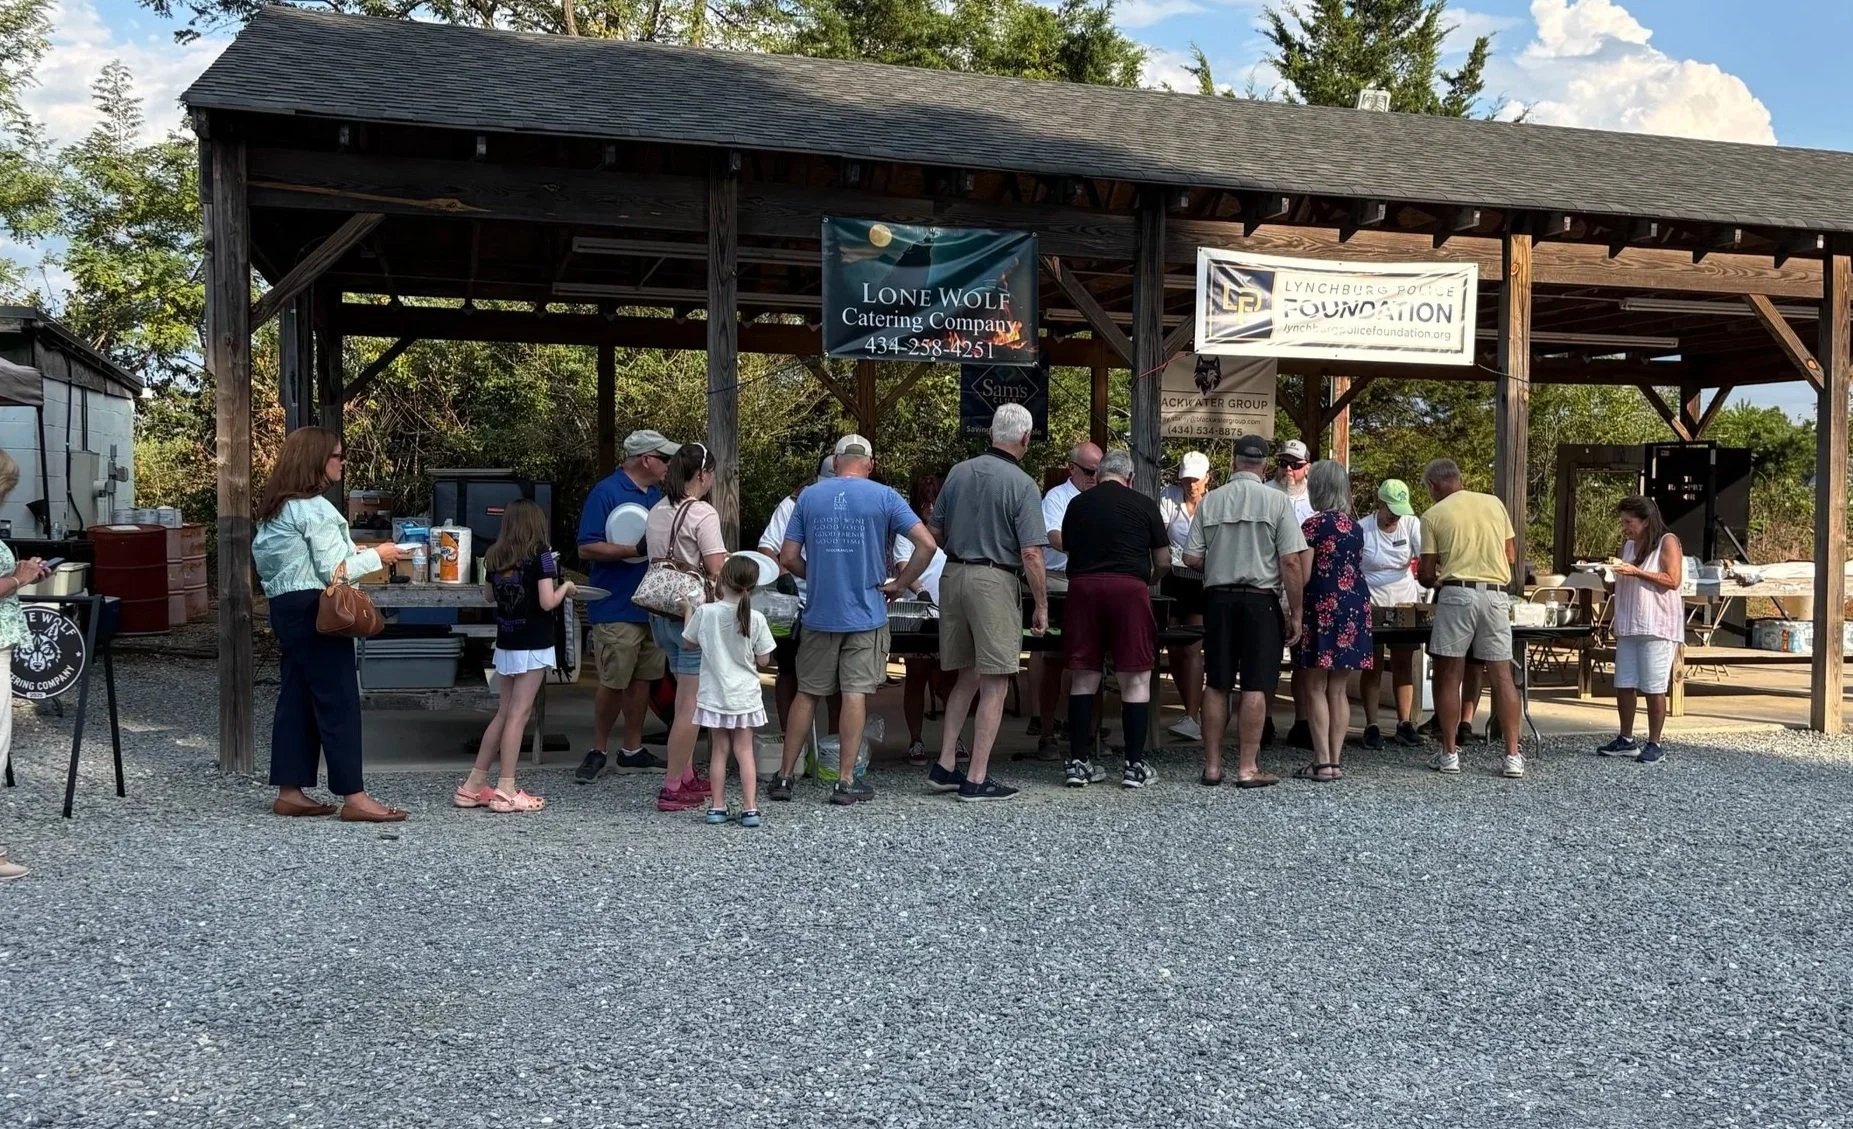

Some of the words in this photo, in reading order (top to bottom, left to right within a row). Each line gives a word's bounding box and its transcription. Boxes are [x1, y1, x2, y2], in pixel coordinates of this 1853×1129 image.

[862, 282, 932, 308] LONE
[938, 287, 1012, 311] WOLF
[1285, 281, 1388, 296] LYNCHBURG
[841, 307, 924, 333] Catering
[929, 311, 1019, 336] Company
[1284, 298, 1453, 324] FOUNDATION
[864, 336, 995, 359] 434-258-4251
[1161, 398, 1225, 408] ACKWATER
[1228, 399, 1268, 410] GROUP
[1167, 425, 1194, 436] (434)
[1196, 426, 1243, 437] 534-8875
[42, 612, 77, 636] WOLF
[10, 672, 35, 691] ERING
[37, 664, 75, 691] COMPANY
